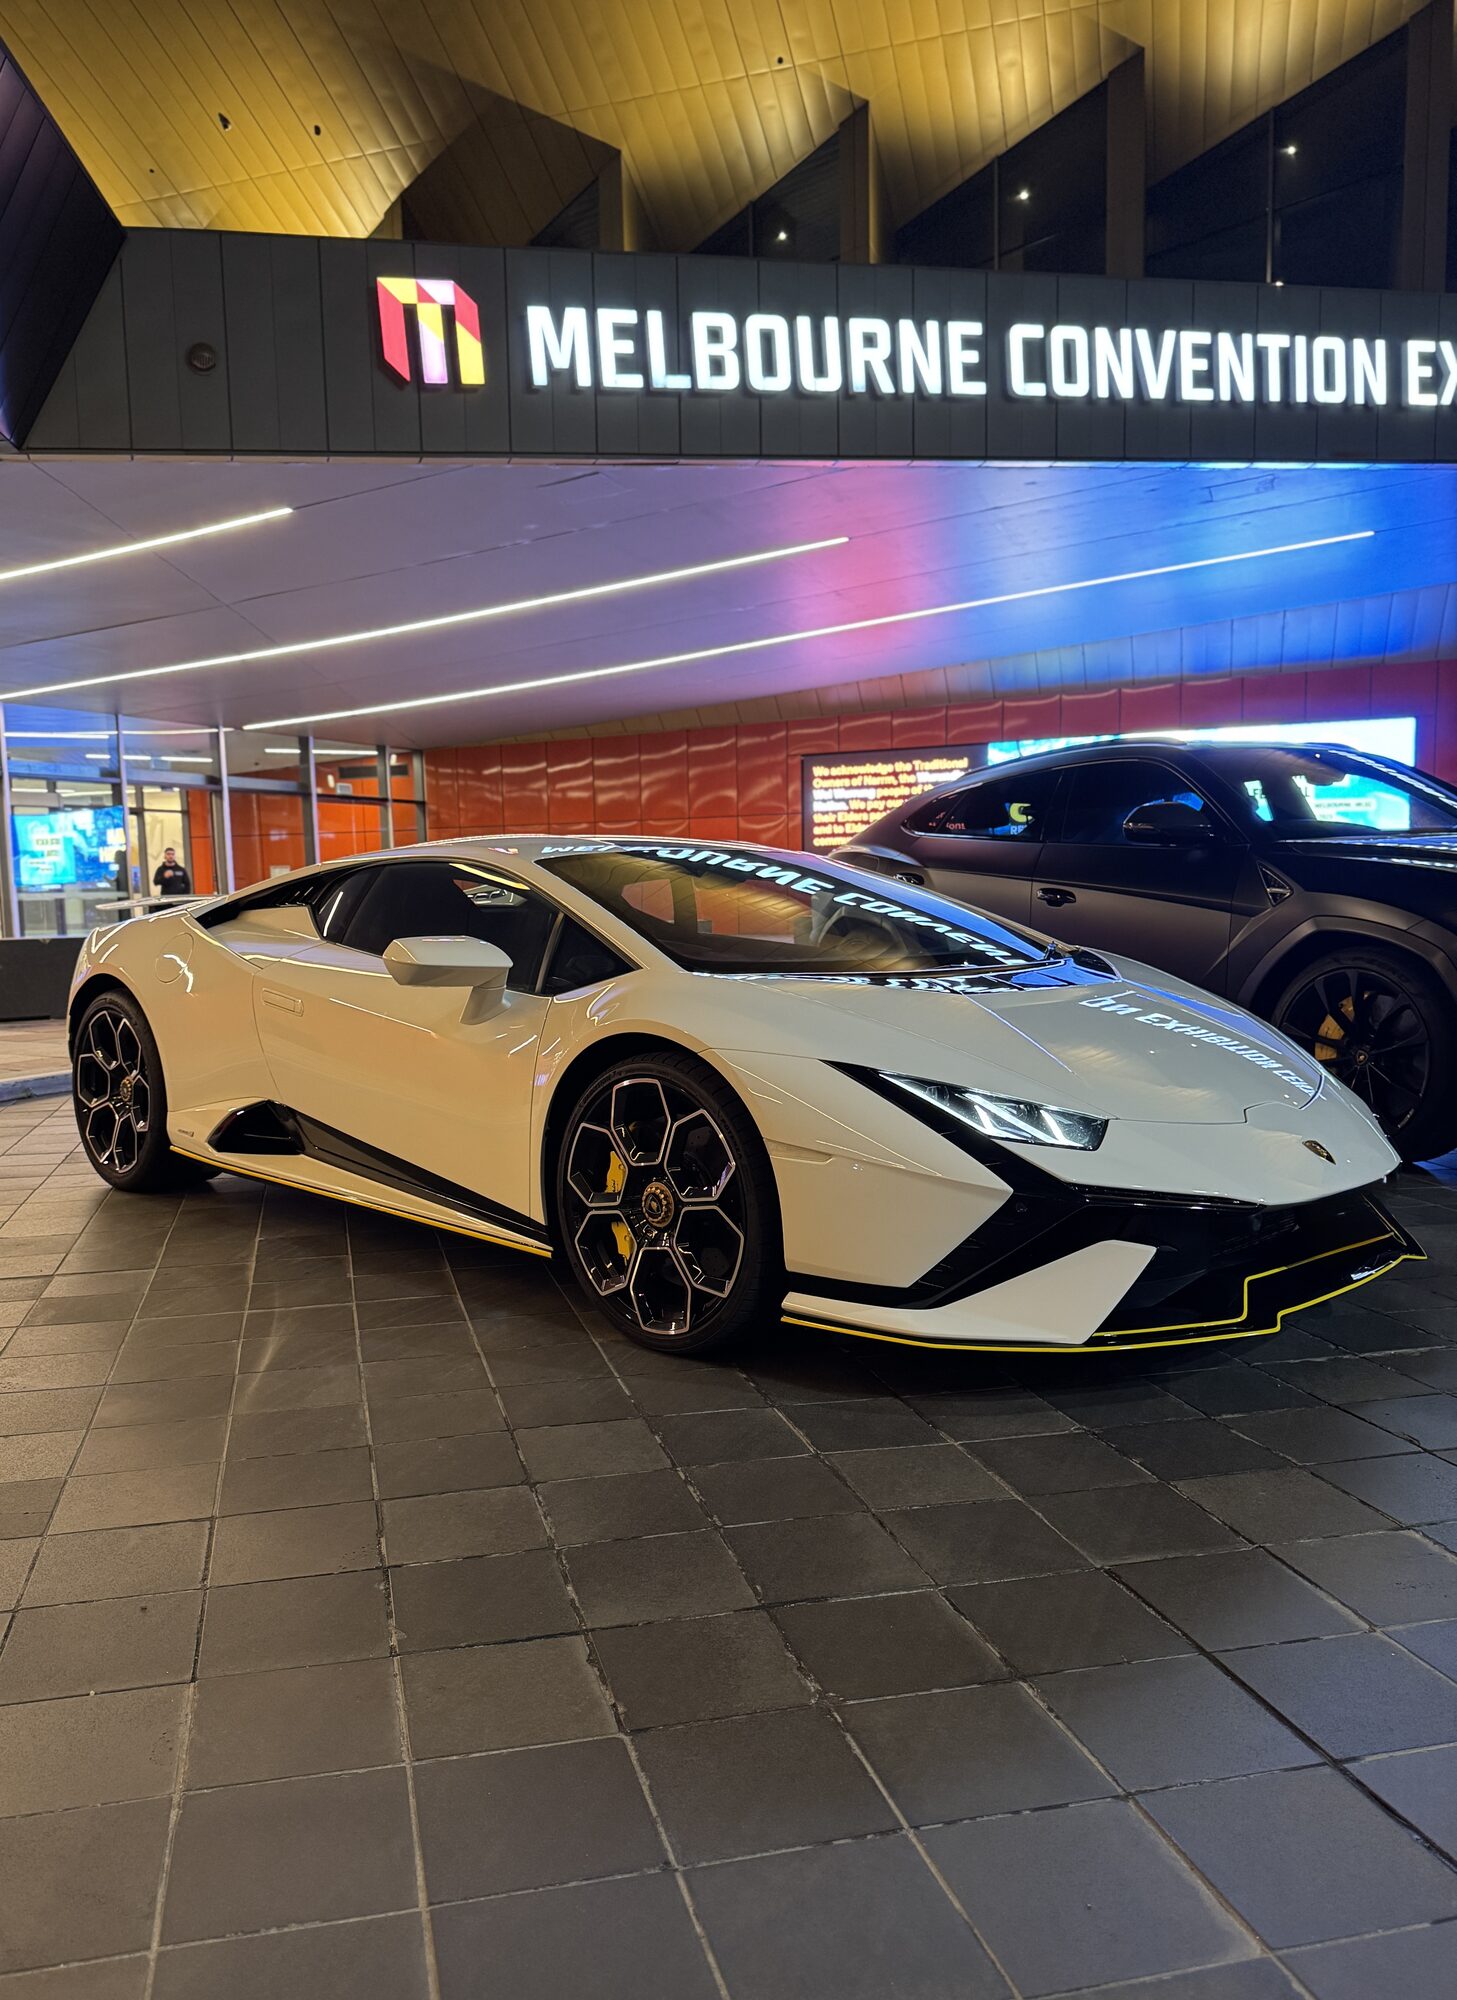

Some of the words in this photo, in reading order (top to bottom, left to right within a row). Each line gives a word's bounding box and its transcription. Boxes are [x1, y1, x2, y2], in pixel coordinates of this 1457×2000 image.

[527, 305, 987, 395] MELBOURNE
[1009, 323, 1387, 405] CONVENTION
[813, 767, 829, 776] We
[830, 763, 894, 776] acknowledge
[895, 762, 912, 771] the
[912, 758, 968, 770] Traditional
[813, 778, 850, 788] Owners
[851, 776, 863, 786] of
[898, 773, 916, 783] the
[911, 784, 923, 794] of
[849, 800, 866, 810] We
[866, 800, 886, 811] pay
[813, 812, 837, 823] their
[813, 824, 832, 834] and
[833, 824, 845, 833] to
